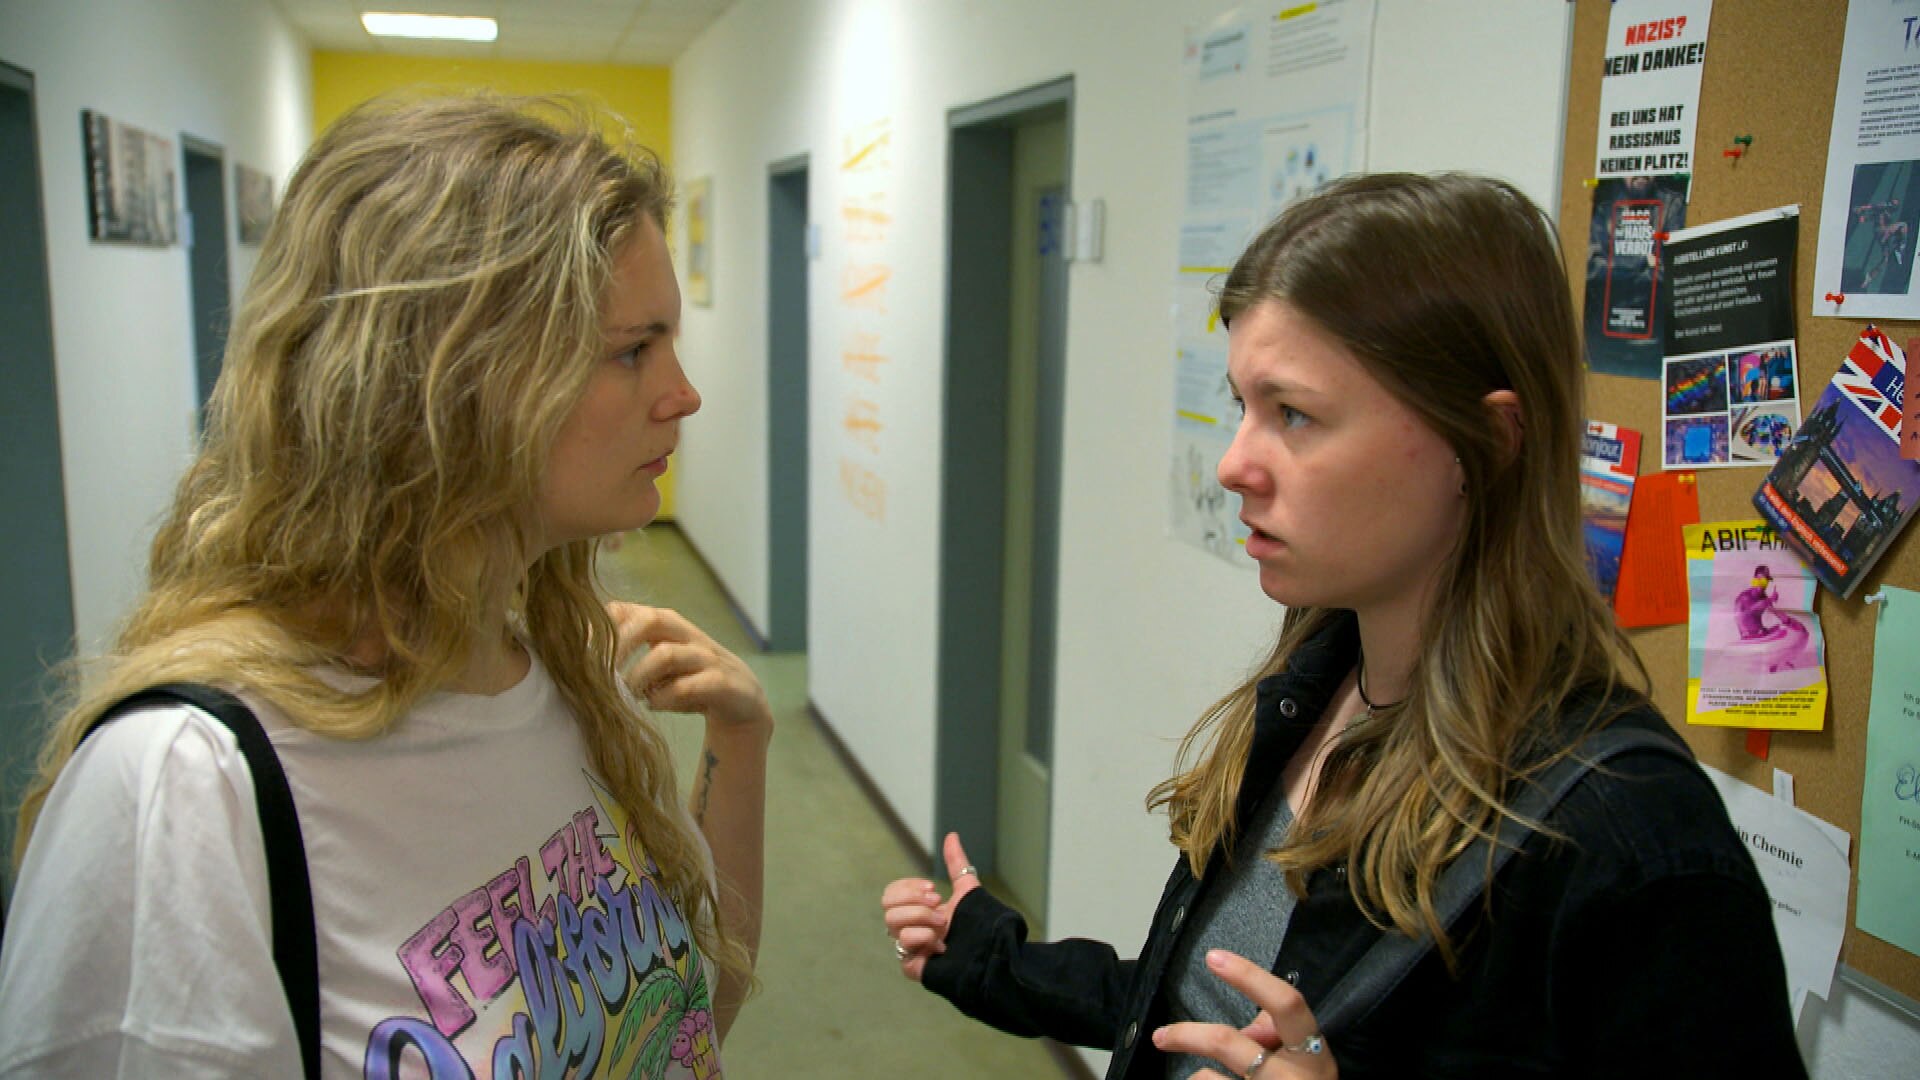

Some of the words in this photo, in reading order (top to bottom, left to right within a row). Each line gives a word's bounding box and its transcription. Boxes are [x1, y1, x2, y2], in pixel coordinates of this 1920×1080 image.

[1625, 16, 1687, 46] NAZIS?
[1642, 42, 1705, 71] DANKE!
[1610, 111, 1630, 128] BEI
[1632, 108, 1656, 126] UNS
[1659, 104, 1684, 124] HAT
[1609, 130, 1681, 150] RASSISMUS
[1600, 155, 1642, 173] KEINEN
[1645, 152, 1689, 170] PLATZ!
[1752, 832, 1803, 868] Chemie
[396, 855, 557, 1037] FEEL
[538, 804, 618, 906] THE
